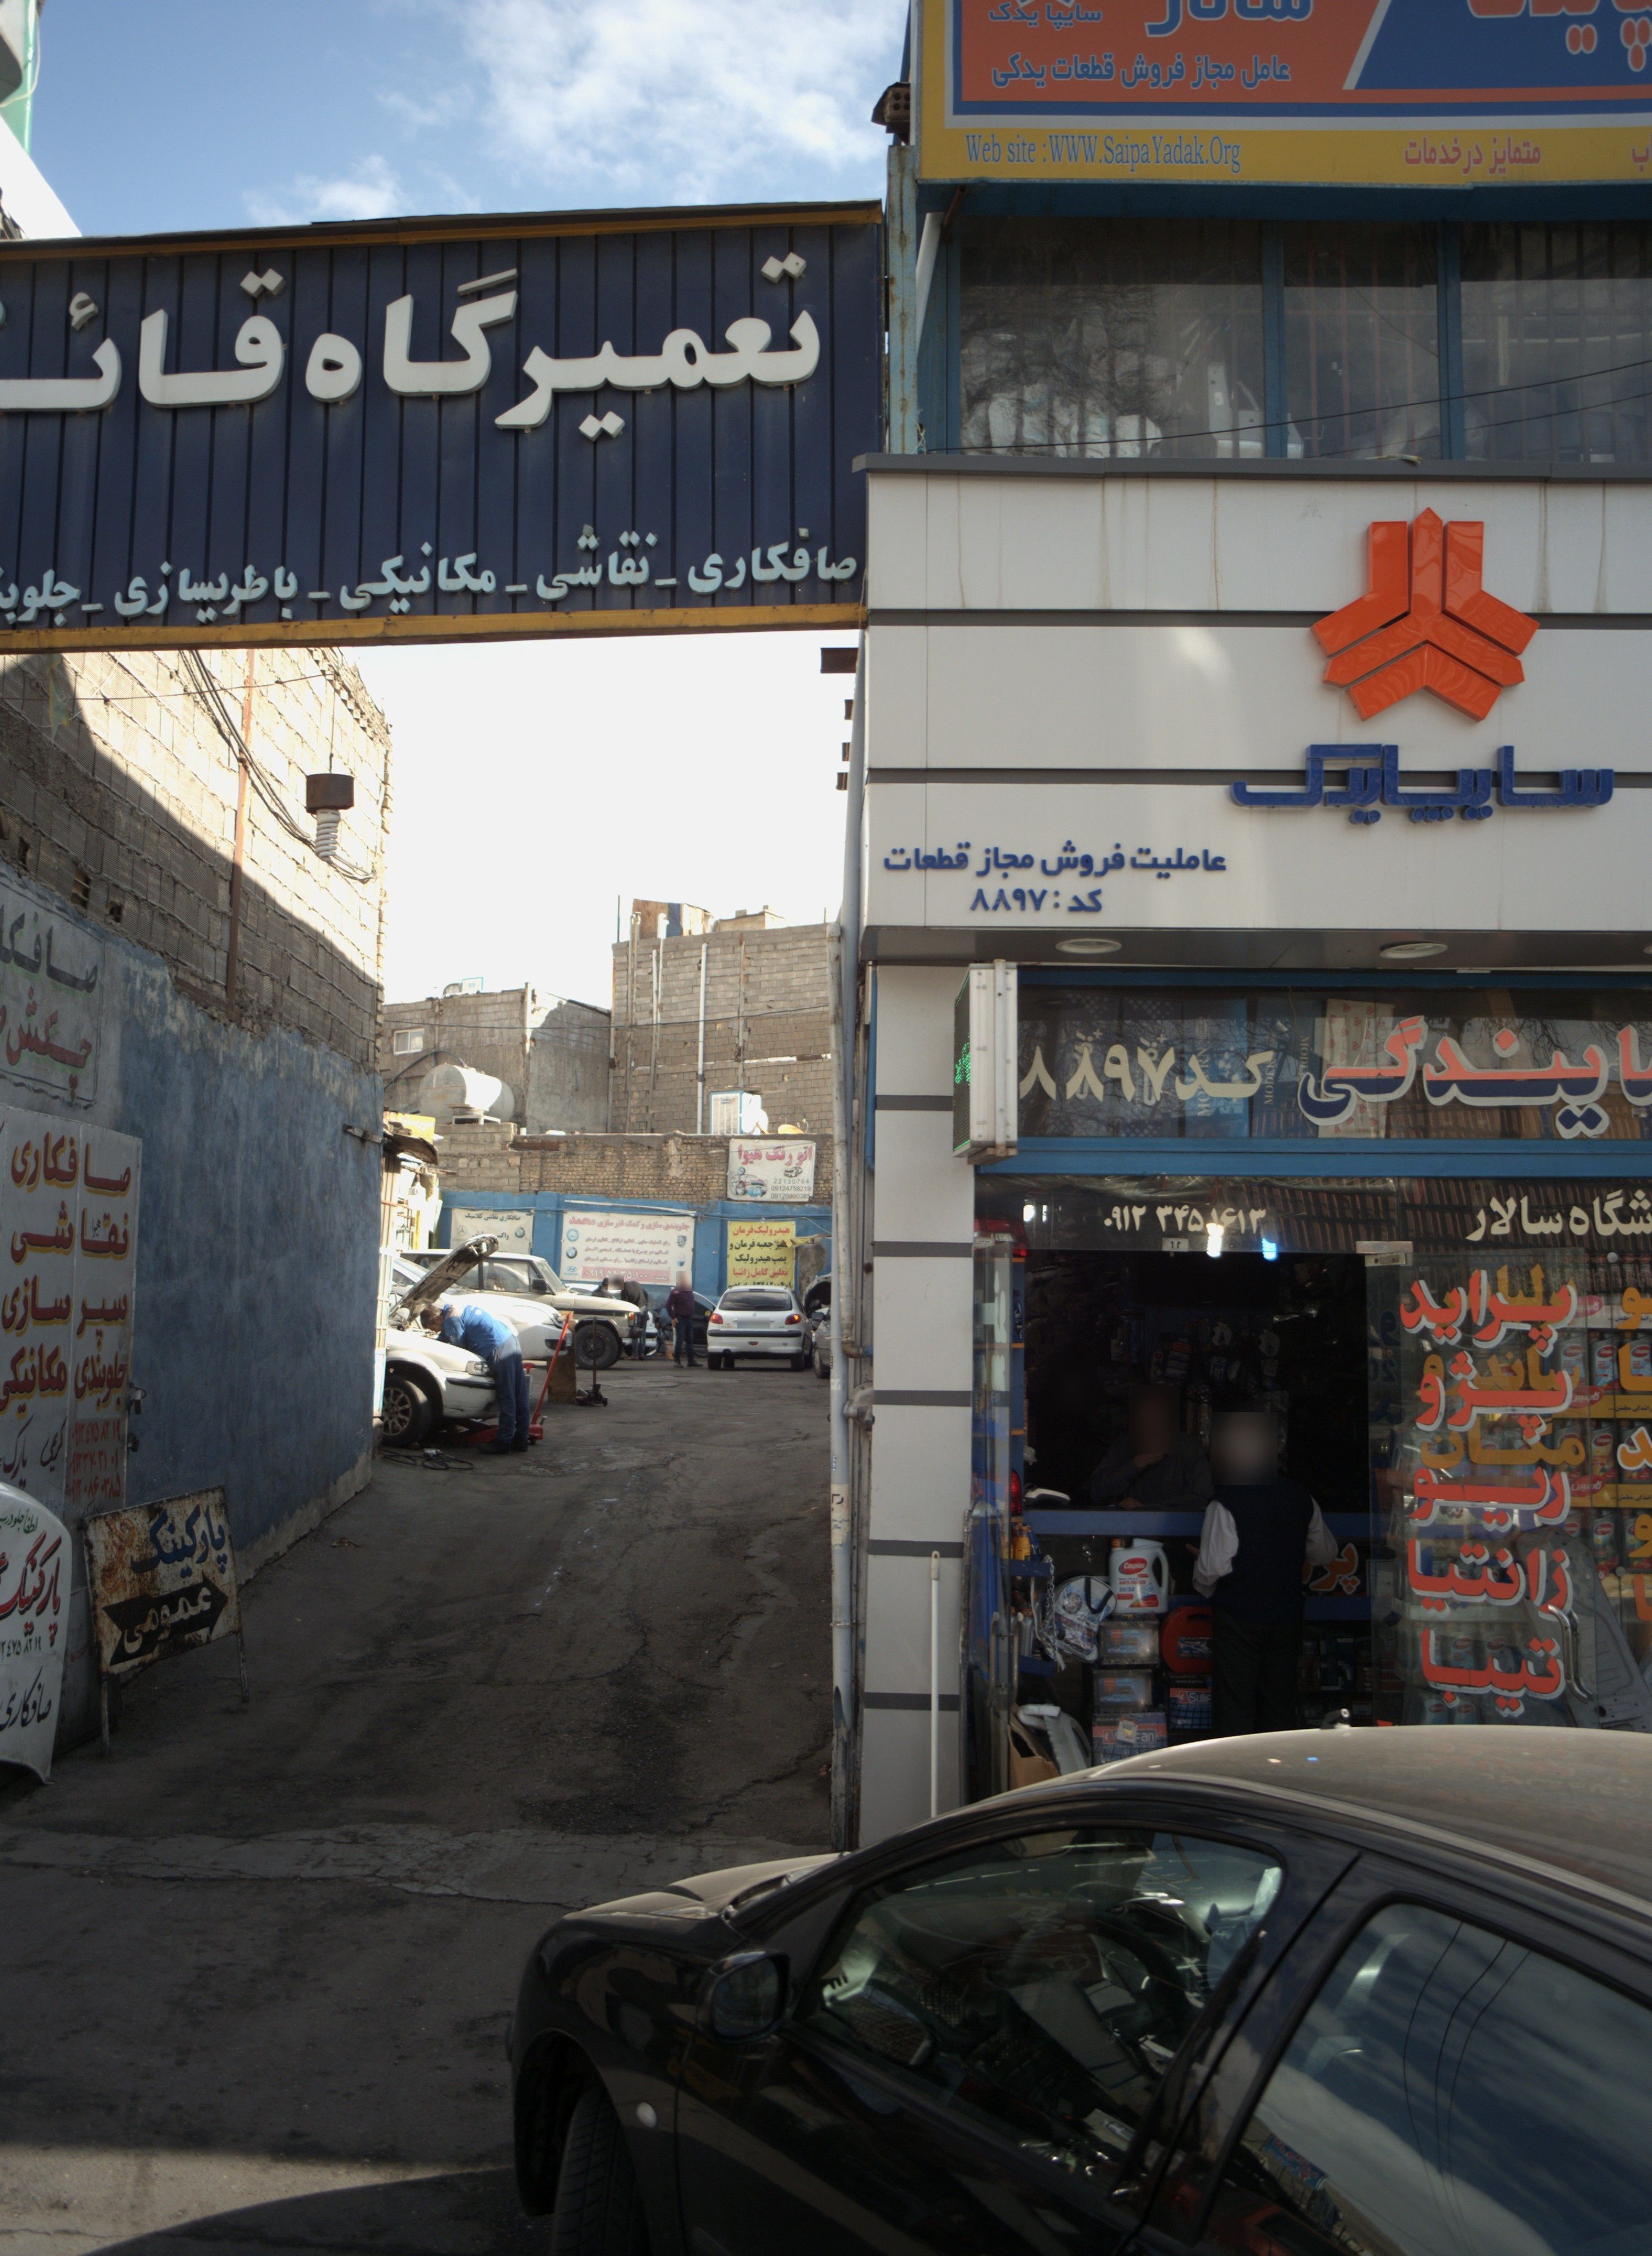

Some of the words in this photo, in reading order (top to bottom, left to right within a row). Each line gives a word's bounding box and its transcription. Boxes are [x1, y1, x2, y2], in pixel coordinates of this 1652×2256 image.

[988, 2, 1039, 27] یدک
[1046, 2, 1102, 30] سایپا
[991, 52, 1046, 88] یدکی
[1051, 53, 1115, 81] قطعات
[1120, 52, 1185, 89] فروش
[1191, 54, 1235, 89] مجاز
[1241, 55, 1290, 89] عامل
[965, 134, 1001, 163] Web
[1007, 134, 1037, 164] site
[1488, 136, 1542, 174] متمایز
[0, 268, 286, 412] قائ
[339, 541, 497, 615] مکانیکی
[536, 524, 659, 601] نقاشی
[687, 526, 857, 595] صافکاری
[883, 840, 971, 871] قطعات
[976, 843, 1035, 877] مجاز
[1041, 839, 1127, 877] فروش
[1129, 847, 1228, 880] عاملیت
[1019, 1043, 1176, 1103] ۸۸۹۷
[1297, 1015, 1652, 1138] ایندگی
[11, 1131, 132, 1197] صافکاری
[738, 1145, 763, 1165] هیوا
[795, 1146, 813, 1165] اتو
[11, 1200, 130, 1265] نقاشی
[1104, 1204, 1146, 1232] ۰۹۱۲
[1466, 1195, 1562, 1241] سالار
[734, 1239, 756, 1250] فرمان
[735, 1254, 771, 1264] هیدرولیک
[772, 1256, 787, 1265] پمپ
[732, 1267, 751, 1278] زانتیا
[751, 1267, 769, 1278] کامل
[769, 1268, 788, 1278] تعلیق
[2, 1274, 72, 1338] سازی
[76, 1294, 131, 1351] سپر
[1399, 1268, 1578, 1357] پراید
[74, 1351, 129, 1412] جلوبندی
[1415, 1351, 1573, 1445] پژو
[1409, 1466, 1571, 1534] ریو
[1407, 1538, 1573, 1622] زانتیا
[124, 1586, 213, 1653] عمومی
[1420, 1628, 1565, 1718] تیبا
